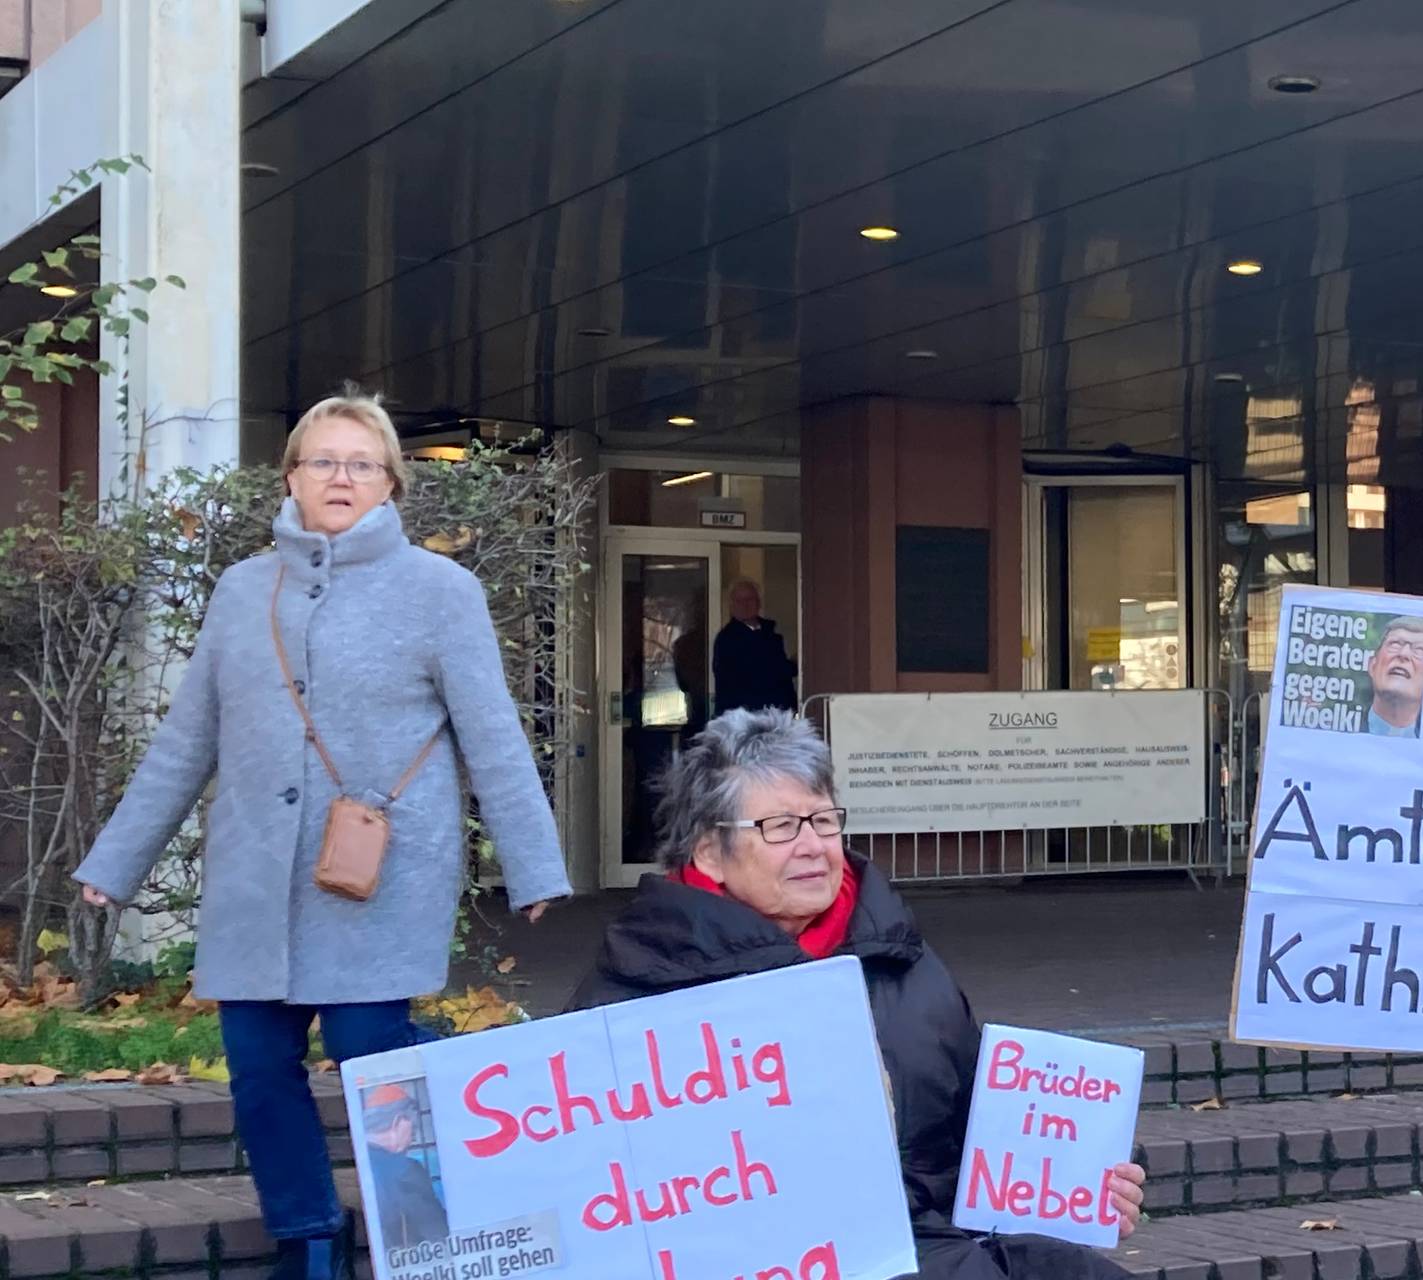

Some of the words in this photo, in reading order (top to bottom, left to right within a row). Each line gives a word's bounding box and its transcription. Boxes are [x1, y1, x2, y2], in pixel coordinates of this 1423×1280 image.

[1291, 606, 1368, 640] Eigene
[1288, 637, 1375, 672] Berater
[1284, 672, 1355, 702] gegen
[989, 712, 1058, 728] ZUGANG
[1283, 699, 1363, 733] Woelki
[1074, 760, 1098, 769] SOWIE
[987, 1039, 1121, 1103] Brüder
[462, 1022, 792, 1158] Schuldig
[1022, 1103, 1077, 1142] im
[581, 1130, 778, 1232] durch
[966, 1147, 1118, 1226] Nebel
[389, 1242, 444, 1269] Große
[449, 1225, 533, 1257] Umfrage:
[463, 1256, 493, 1280] soll
[499, 1248, 554, 1278] gehen
